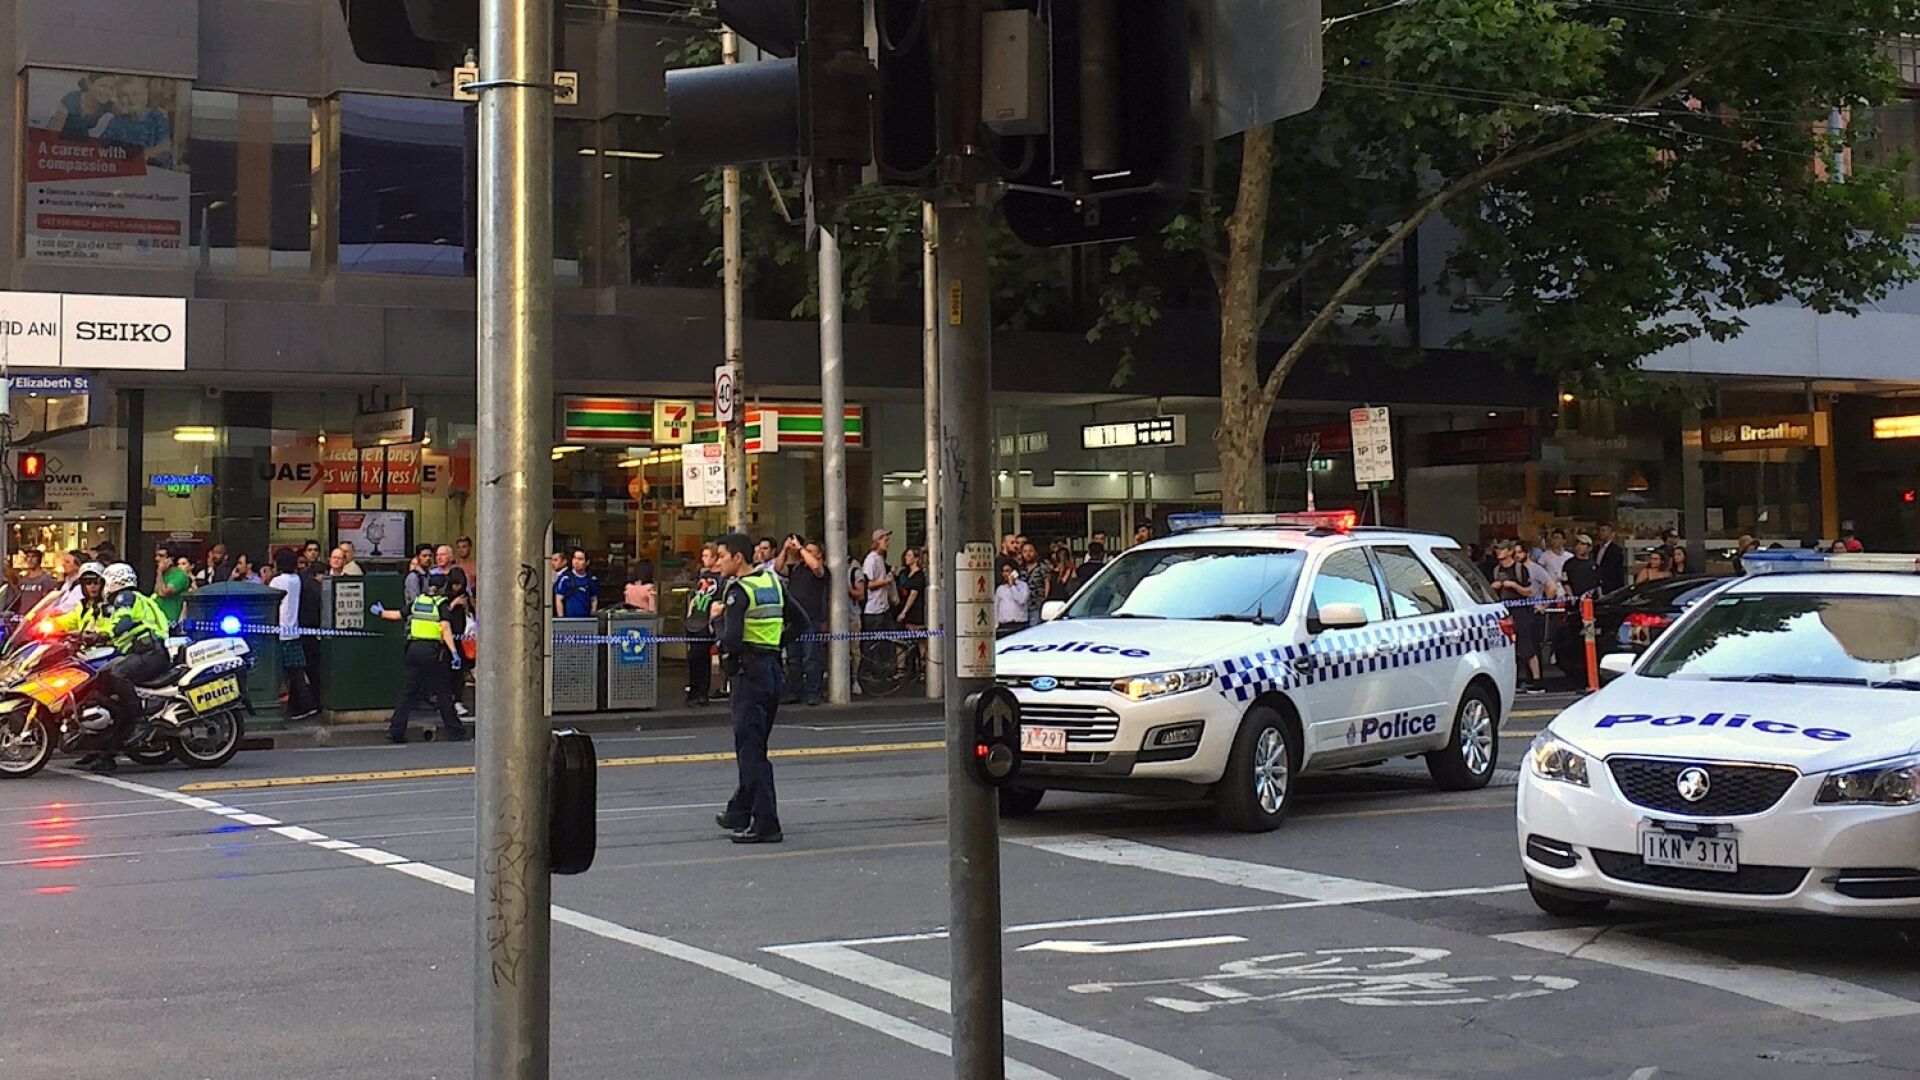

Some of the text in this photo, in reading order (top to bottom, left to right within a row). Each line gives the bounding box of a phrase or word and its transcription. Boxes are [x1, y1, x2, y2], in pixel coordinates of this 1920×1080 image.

[38, 142, 127, 159] A career with
[38, 159, 117, 173] compassion
[27, 321, 57, 336] ANI
[76, 321, 172, 343] SEIKO
[16, 376, 88, 389] Elizabeth St
[663, 420, 687, 428] ELEVEN
[665, 405, 687, 438] 7
[1740, 421, 1808, 441] Breadtop
[329, 448, 372, 461] receie
[1357, 446, 1368, 455] 1P
[1376, 445, 1387, 454] 1P
[45, 474, 83, 484] own
[258, 463, 312, 481] UAE
[340, 466, 368, 483] wih
[708, 466, 720, 476] 1P
[997, 641, 1150, 658] Police
[196, 684, 235, 704] POLICE
[1360, 711, 1436, 743] Police
[1594, 713, 1852, 741] Police
[1042, 731, 1063, 747] 297
[1697, 841, 1734, 865] 3TX
